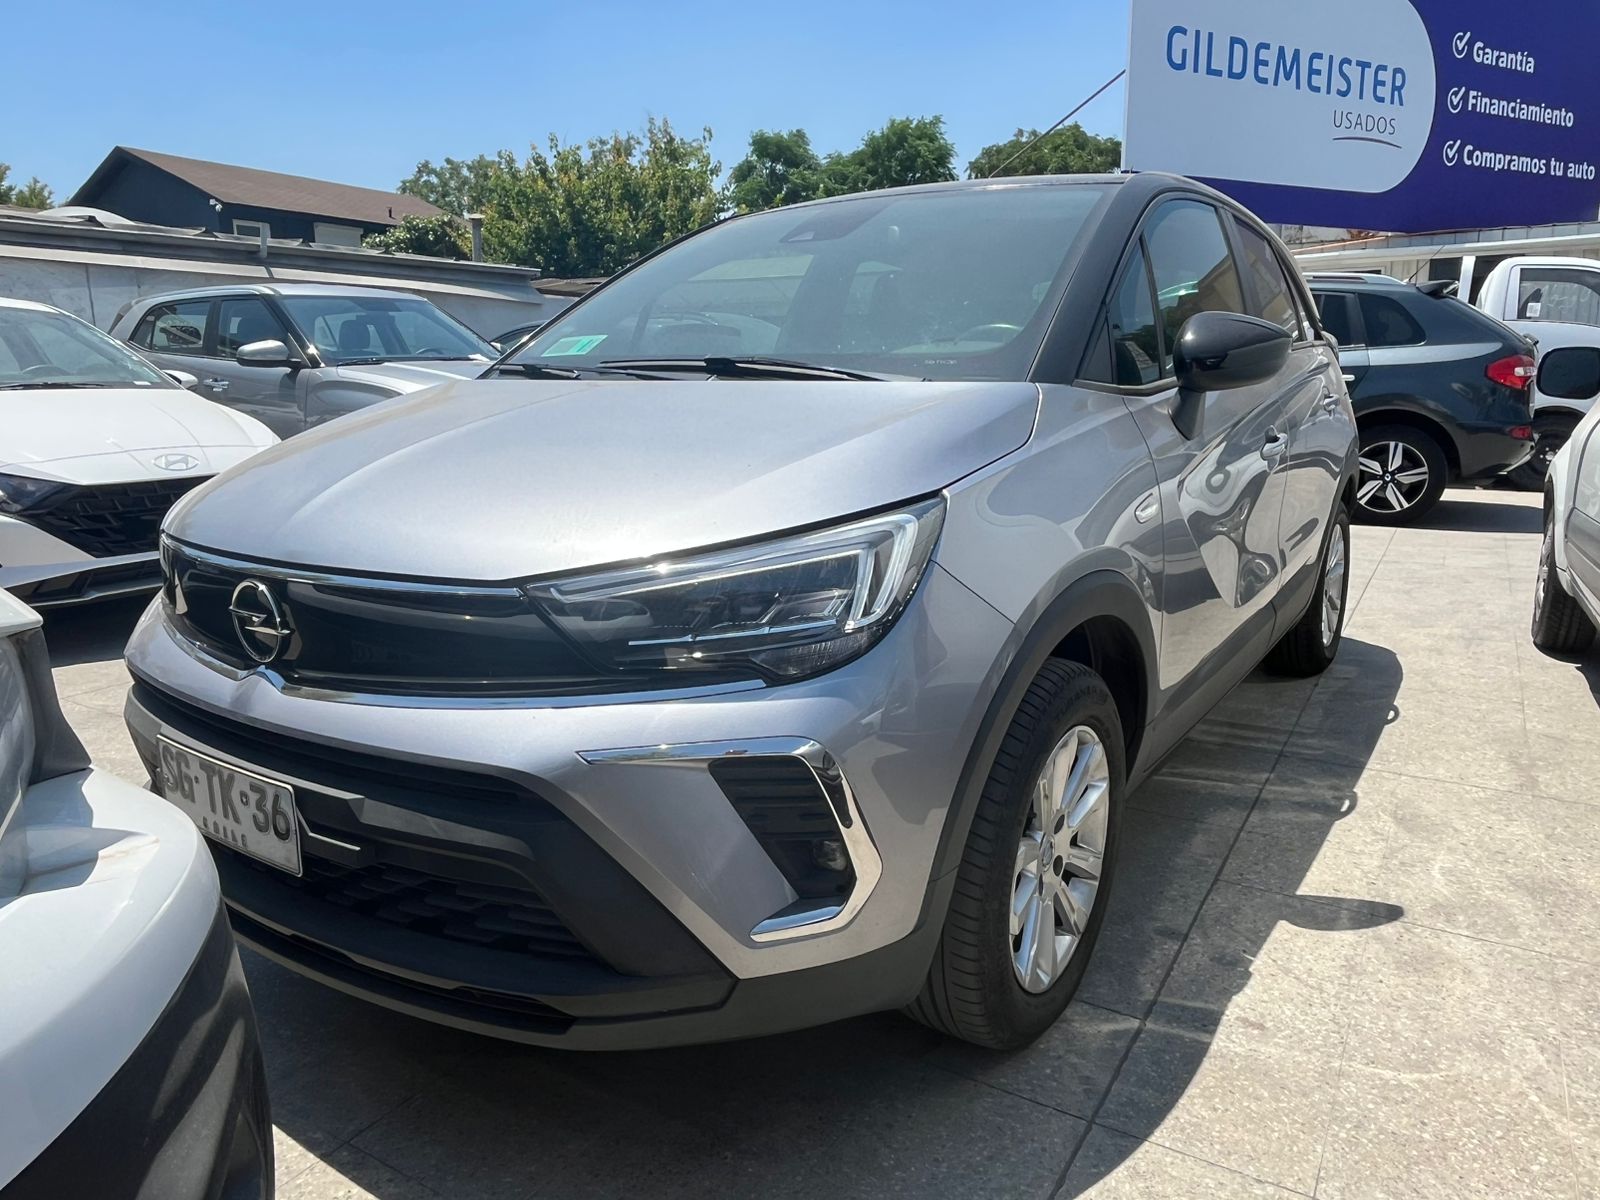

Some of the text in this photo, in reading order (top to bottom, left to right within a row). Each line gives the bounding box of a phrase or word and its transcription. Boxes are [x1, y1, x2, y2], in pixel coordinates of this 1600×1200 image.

[1166, 25, 1406, 106] GILDEMEISTER
[1473, 41, 1535, 73] Garantía
[1333, 109, 1396, 135] USADOS
[1467, 90, 1574, 127] Financiamiento
[1463, 144, 1596, 180] Compramos tu auto
